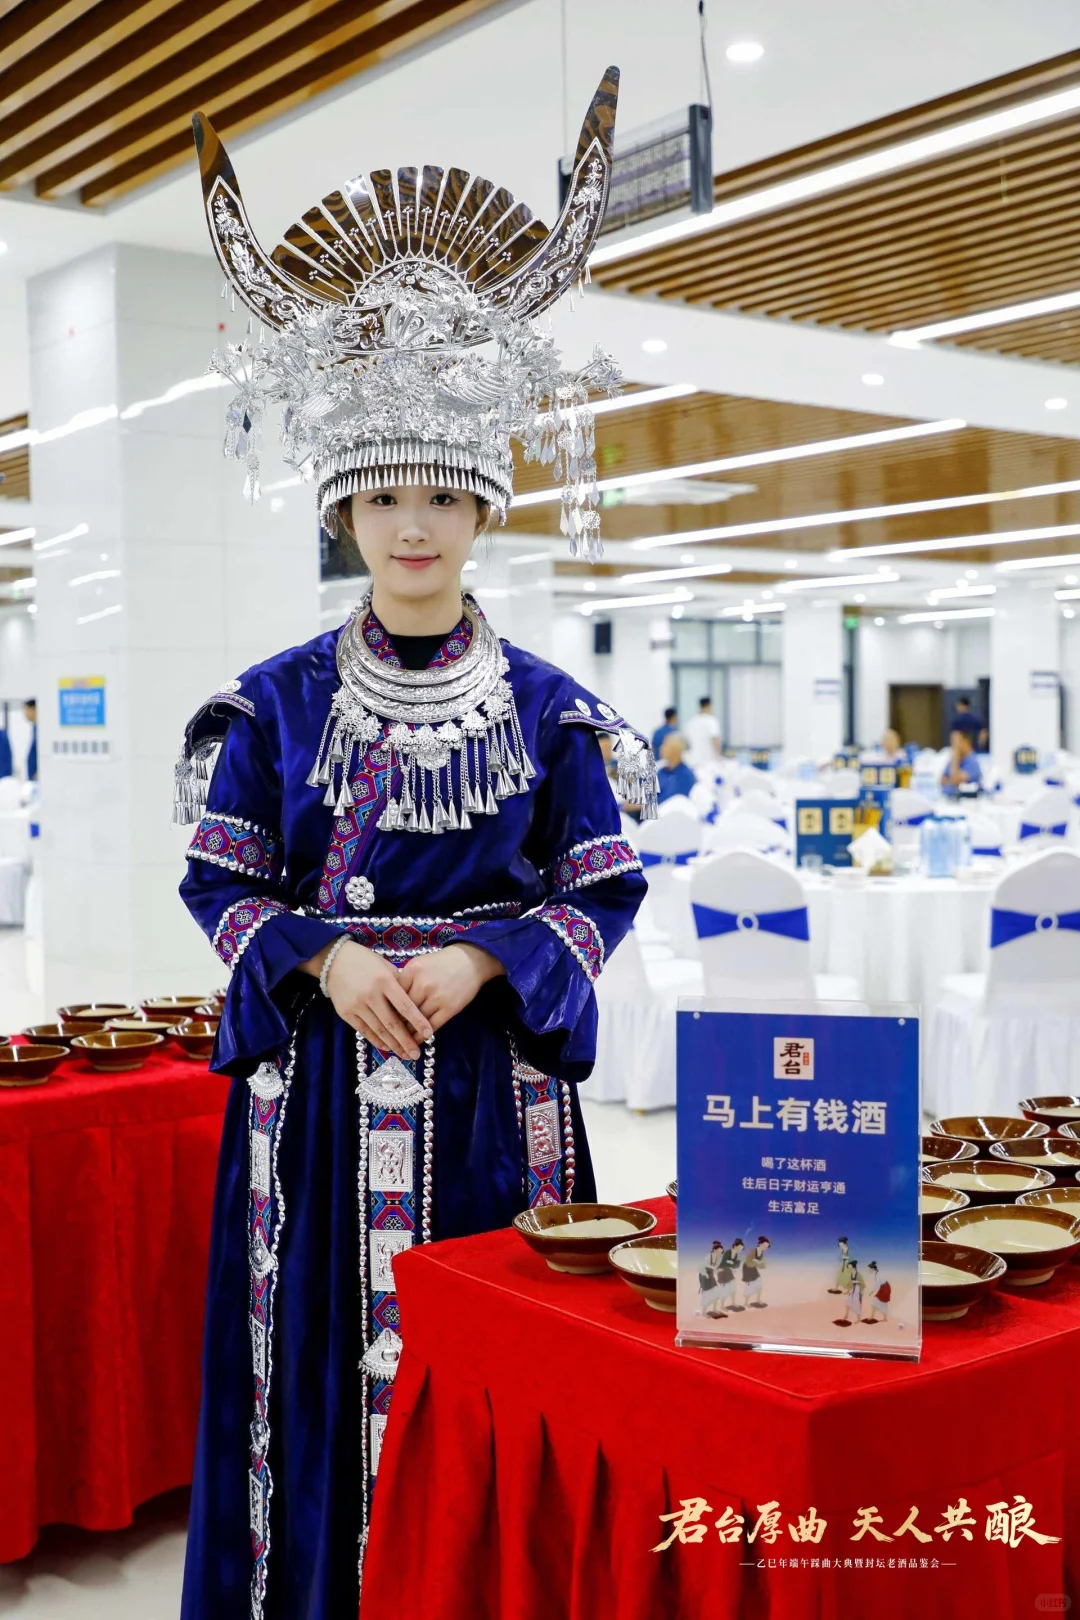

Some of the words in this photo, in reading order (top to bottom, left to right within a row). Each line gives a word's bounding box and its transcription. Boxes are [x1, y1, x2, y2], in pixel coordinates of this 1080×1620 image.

[780, 1042, 805, 1075] 君台
[703, 1094, 887, 1135] 马上有钱酒
[761, 1156, 827, 1172] 喝了这杯酒
[742, 1177, 846, 1194] 往后日子财运亨通
[768, 1200, 820, 1215] 生活富足
